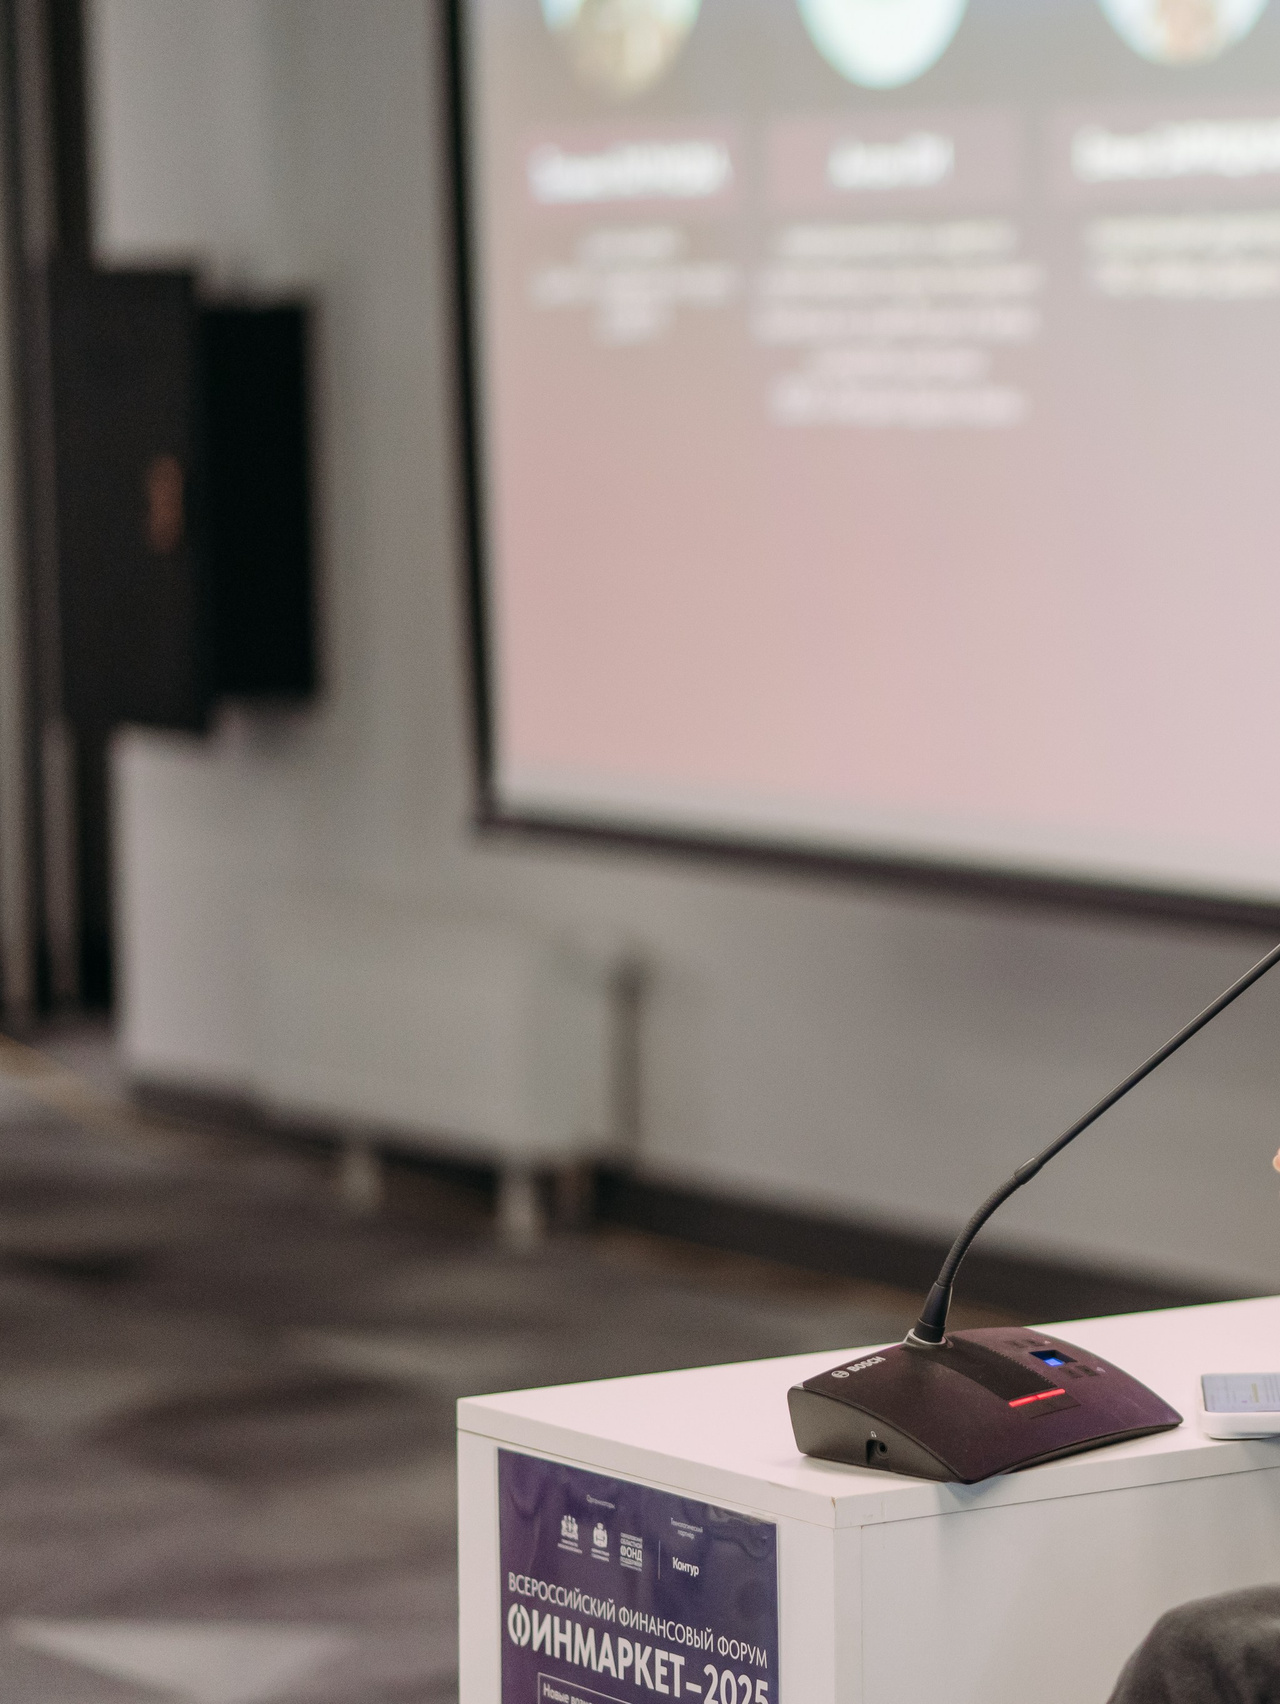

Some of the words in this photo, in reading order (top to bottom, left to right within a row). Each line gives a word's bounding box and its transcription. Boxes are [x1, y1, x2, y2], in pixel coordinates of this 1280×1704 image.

[846, 1355, 887, 1372] BOSCH
[620, 1545, 643, 1563] ФОНД
[672, 1556, 700, 1577] Контур
[508, 1571, 616, 1622] ВСЕРОССИЙСКИЙ
[618, 1606, 714, 1652] ФИНАНСОВЫЙ
[717, 1635, 768, 1669] ФОРУМ
